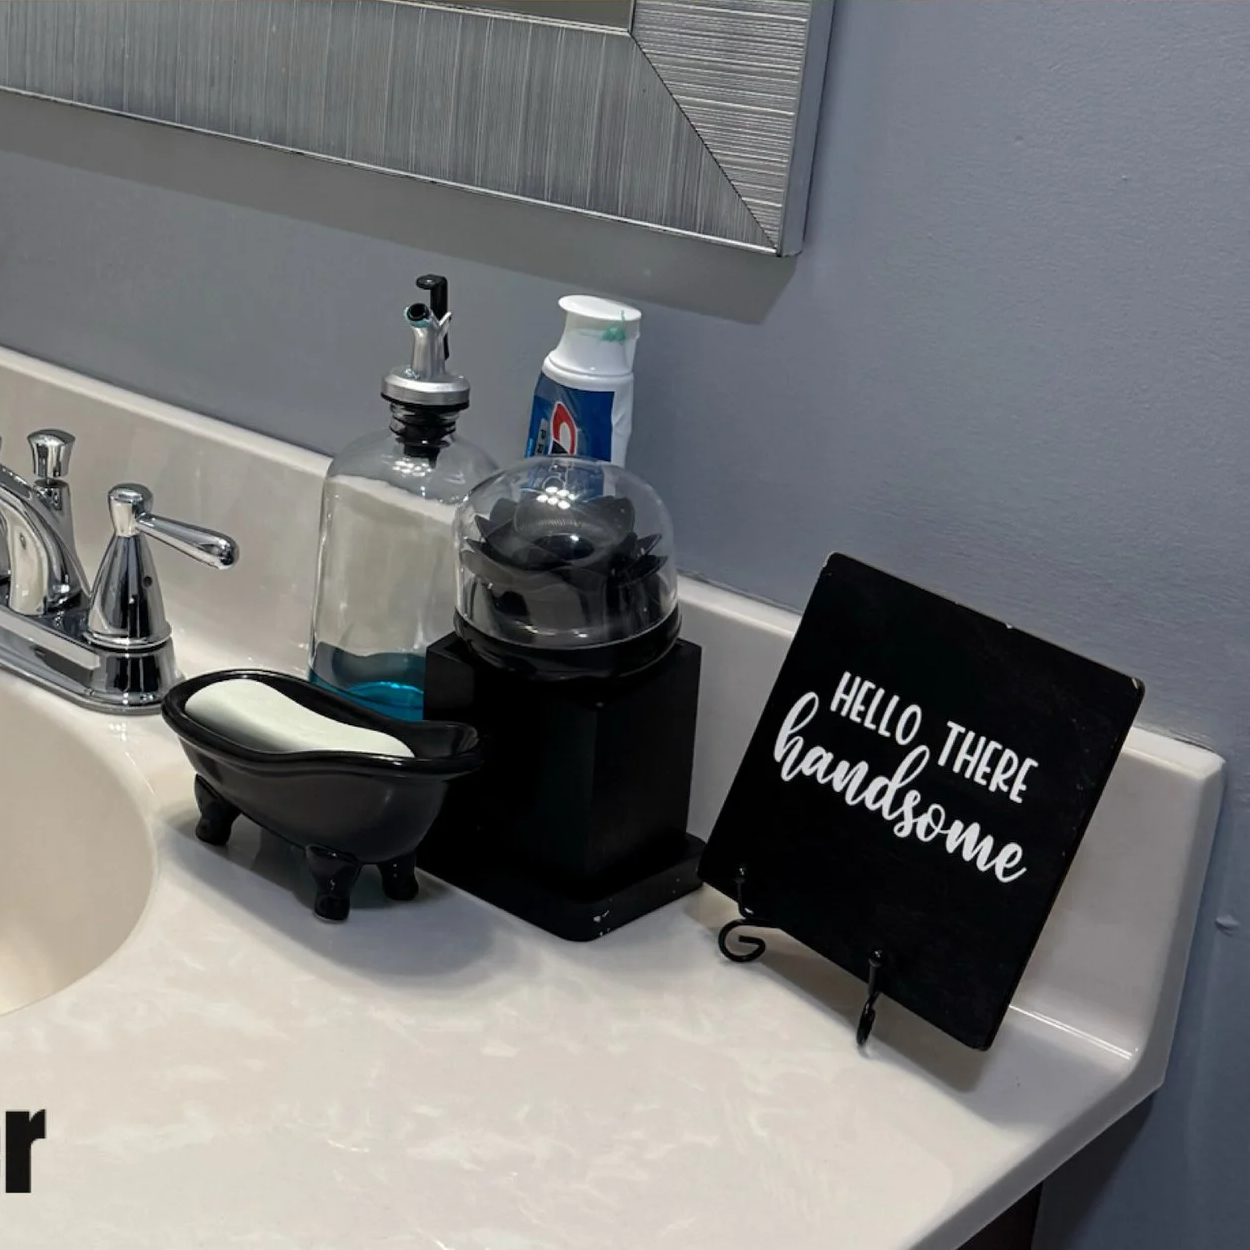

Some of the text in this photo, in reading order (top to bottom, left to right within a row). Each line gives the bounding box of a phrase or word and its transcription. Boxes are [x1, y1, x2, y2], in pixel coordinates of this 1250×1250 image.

[773, 691, 1027, 883] handsome
[830, 671, 1039, 804] HELLO THERE
